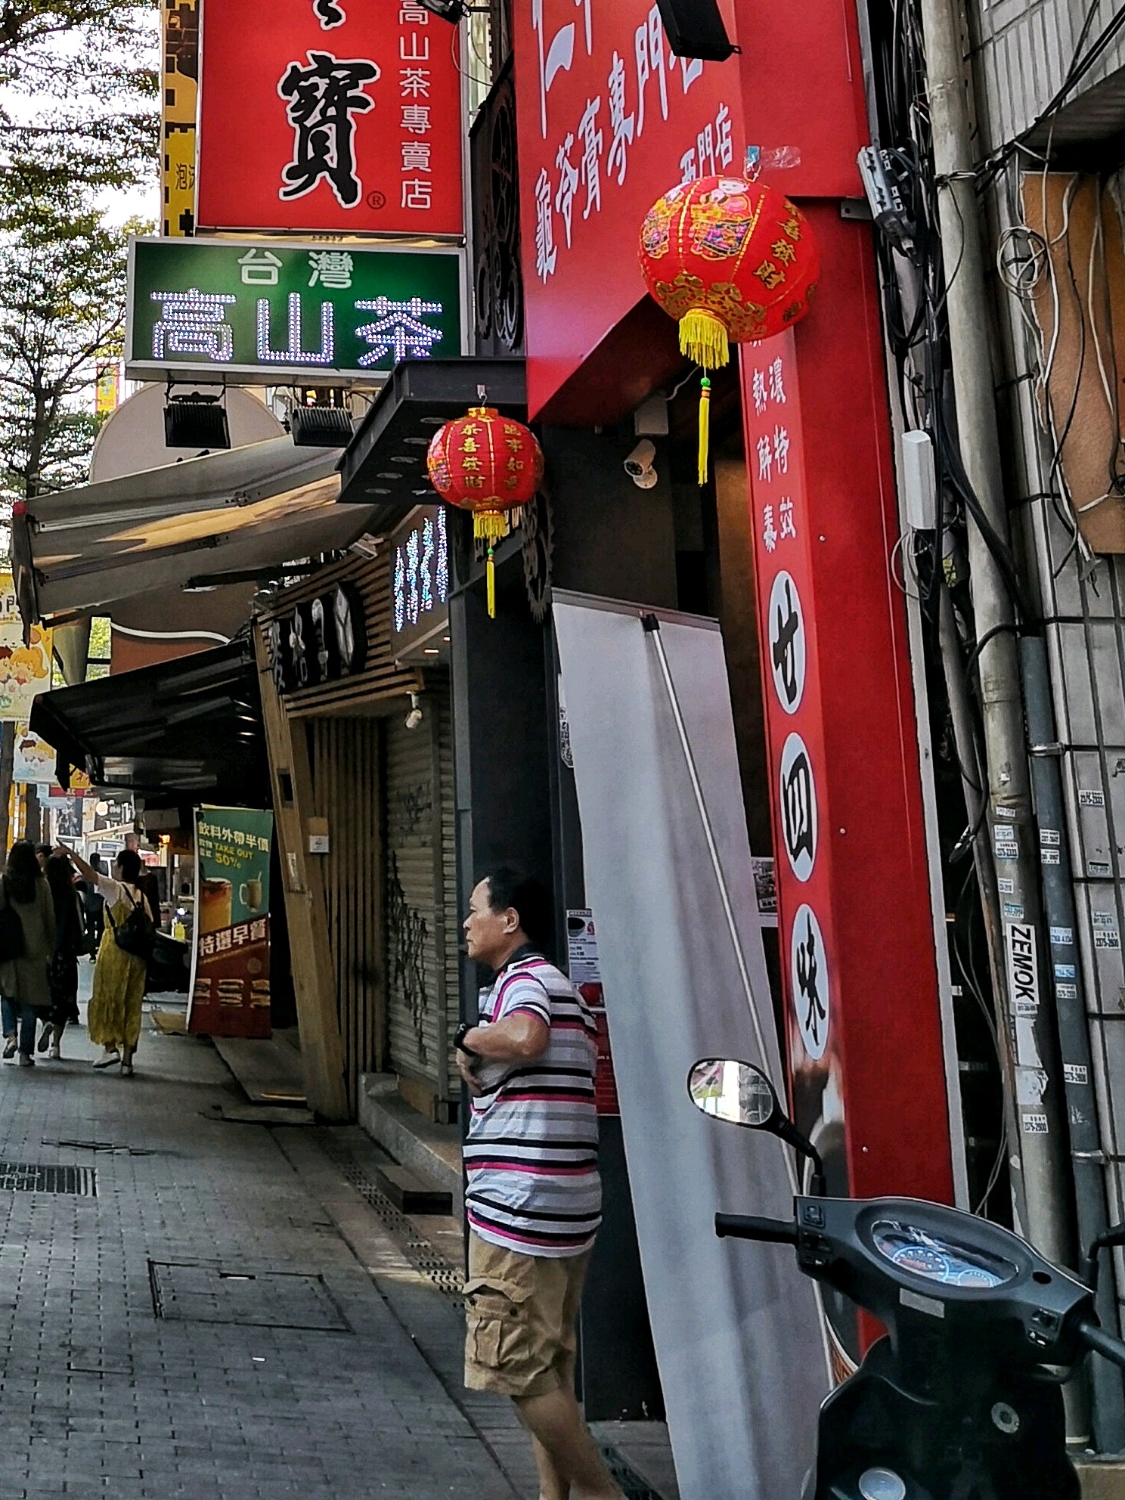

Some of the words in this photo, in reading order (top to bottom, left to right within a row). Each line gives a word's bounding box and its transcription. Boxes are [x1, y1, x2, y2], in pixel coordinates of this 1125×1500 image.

[237, 247, 354, 289] 台灣
[149, 288, 444, 368] 高山茶
[199, 918, 268, 957] 特選早餐
[1010, 924, 1035, 1003] ZEMOK
